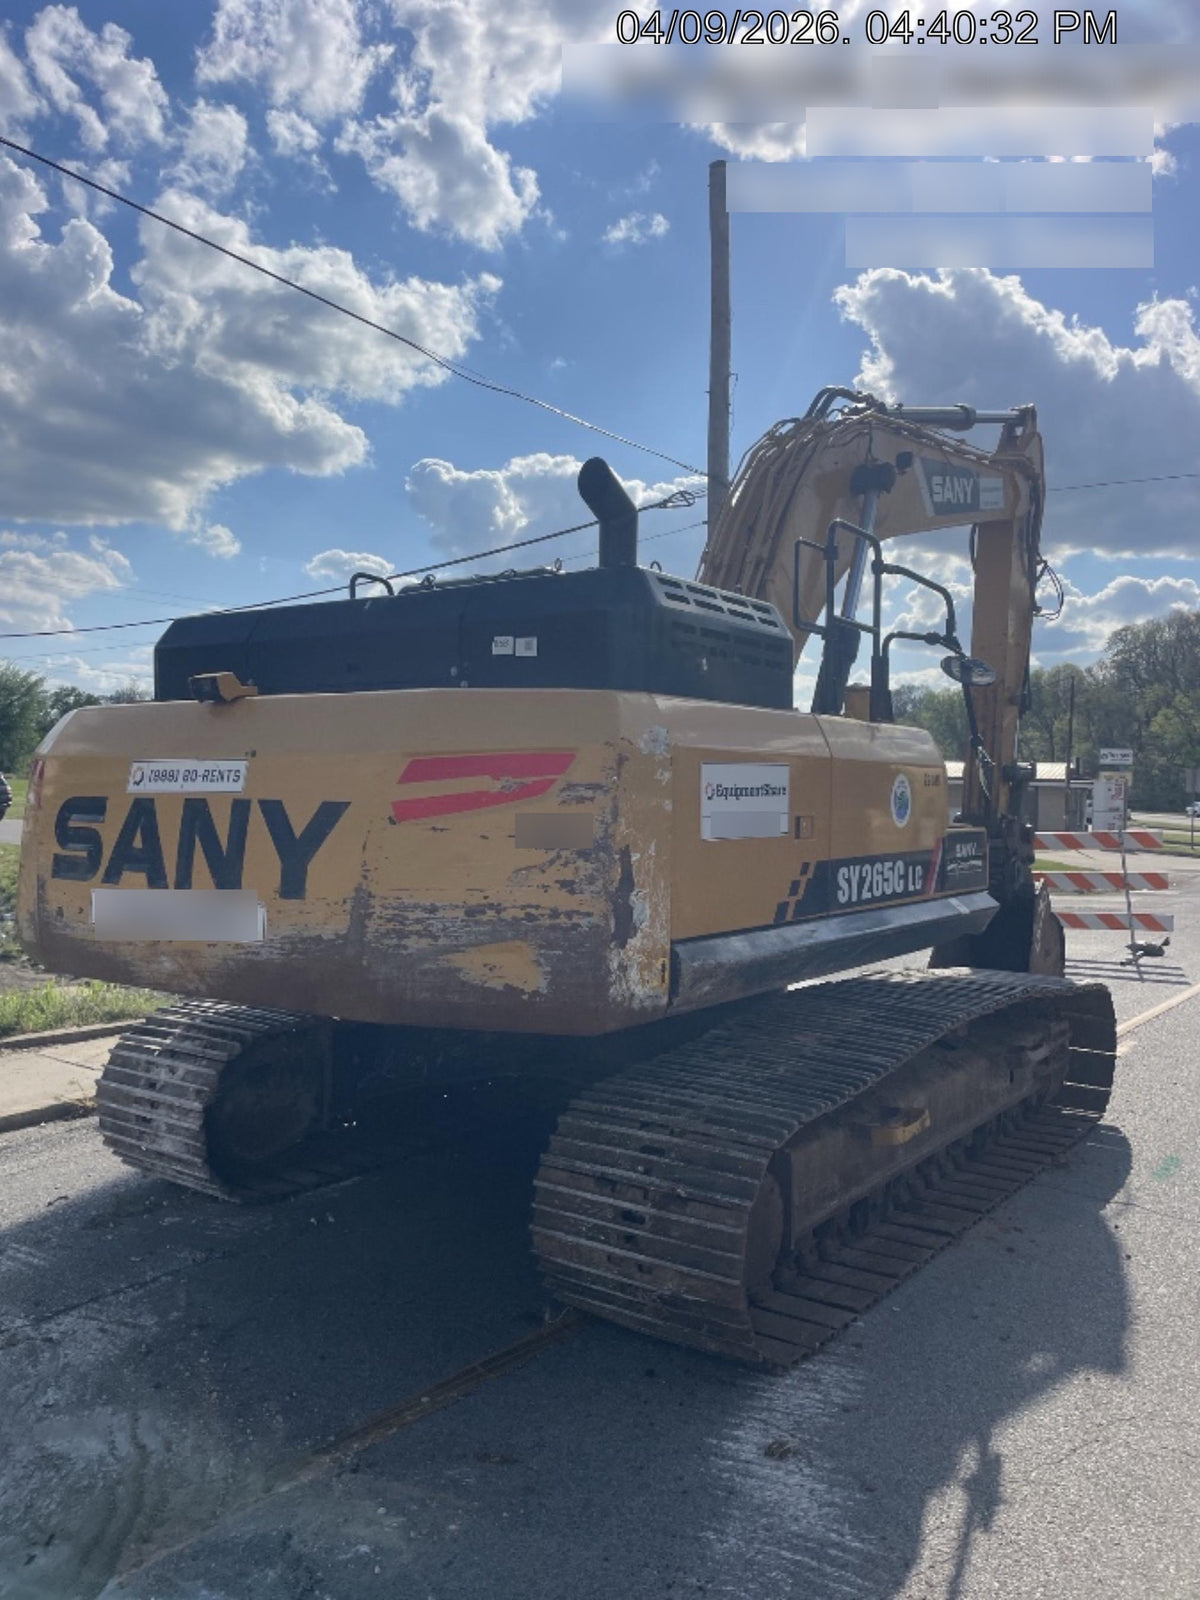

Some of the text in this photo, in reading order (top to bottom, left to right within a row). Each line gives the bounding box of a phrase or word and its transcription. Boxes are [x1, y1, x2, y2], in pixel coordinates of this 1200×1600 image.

[932, 475, 973, 504] SANY
[716, 783, 787, 800] EquipmentShare
[52, 796, 351, 900] SANY
[837, 860, 904, 904] SY265C
